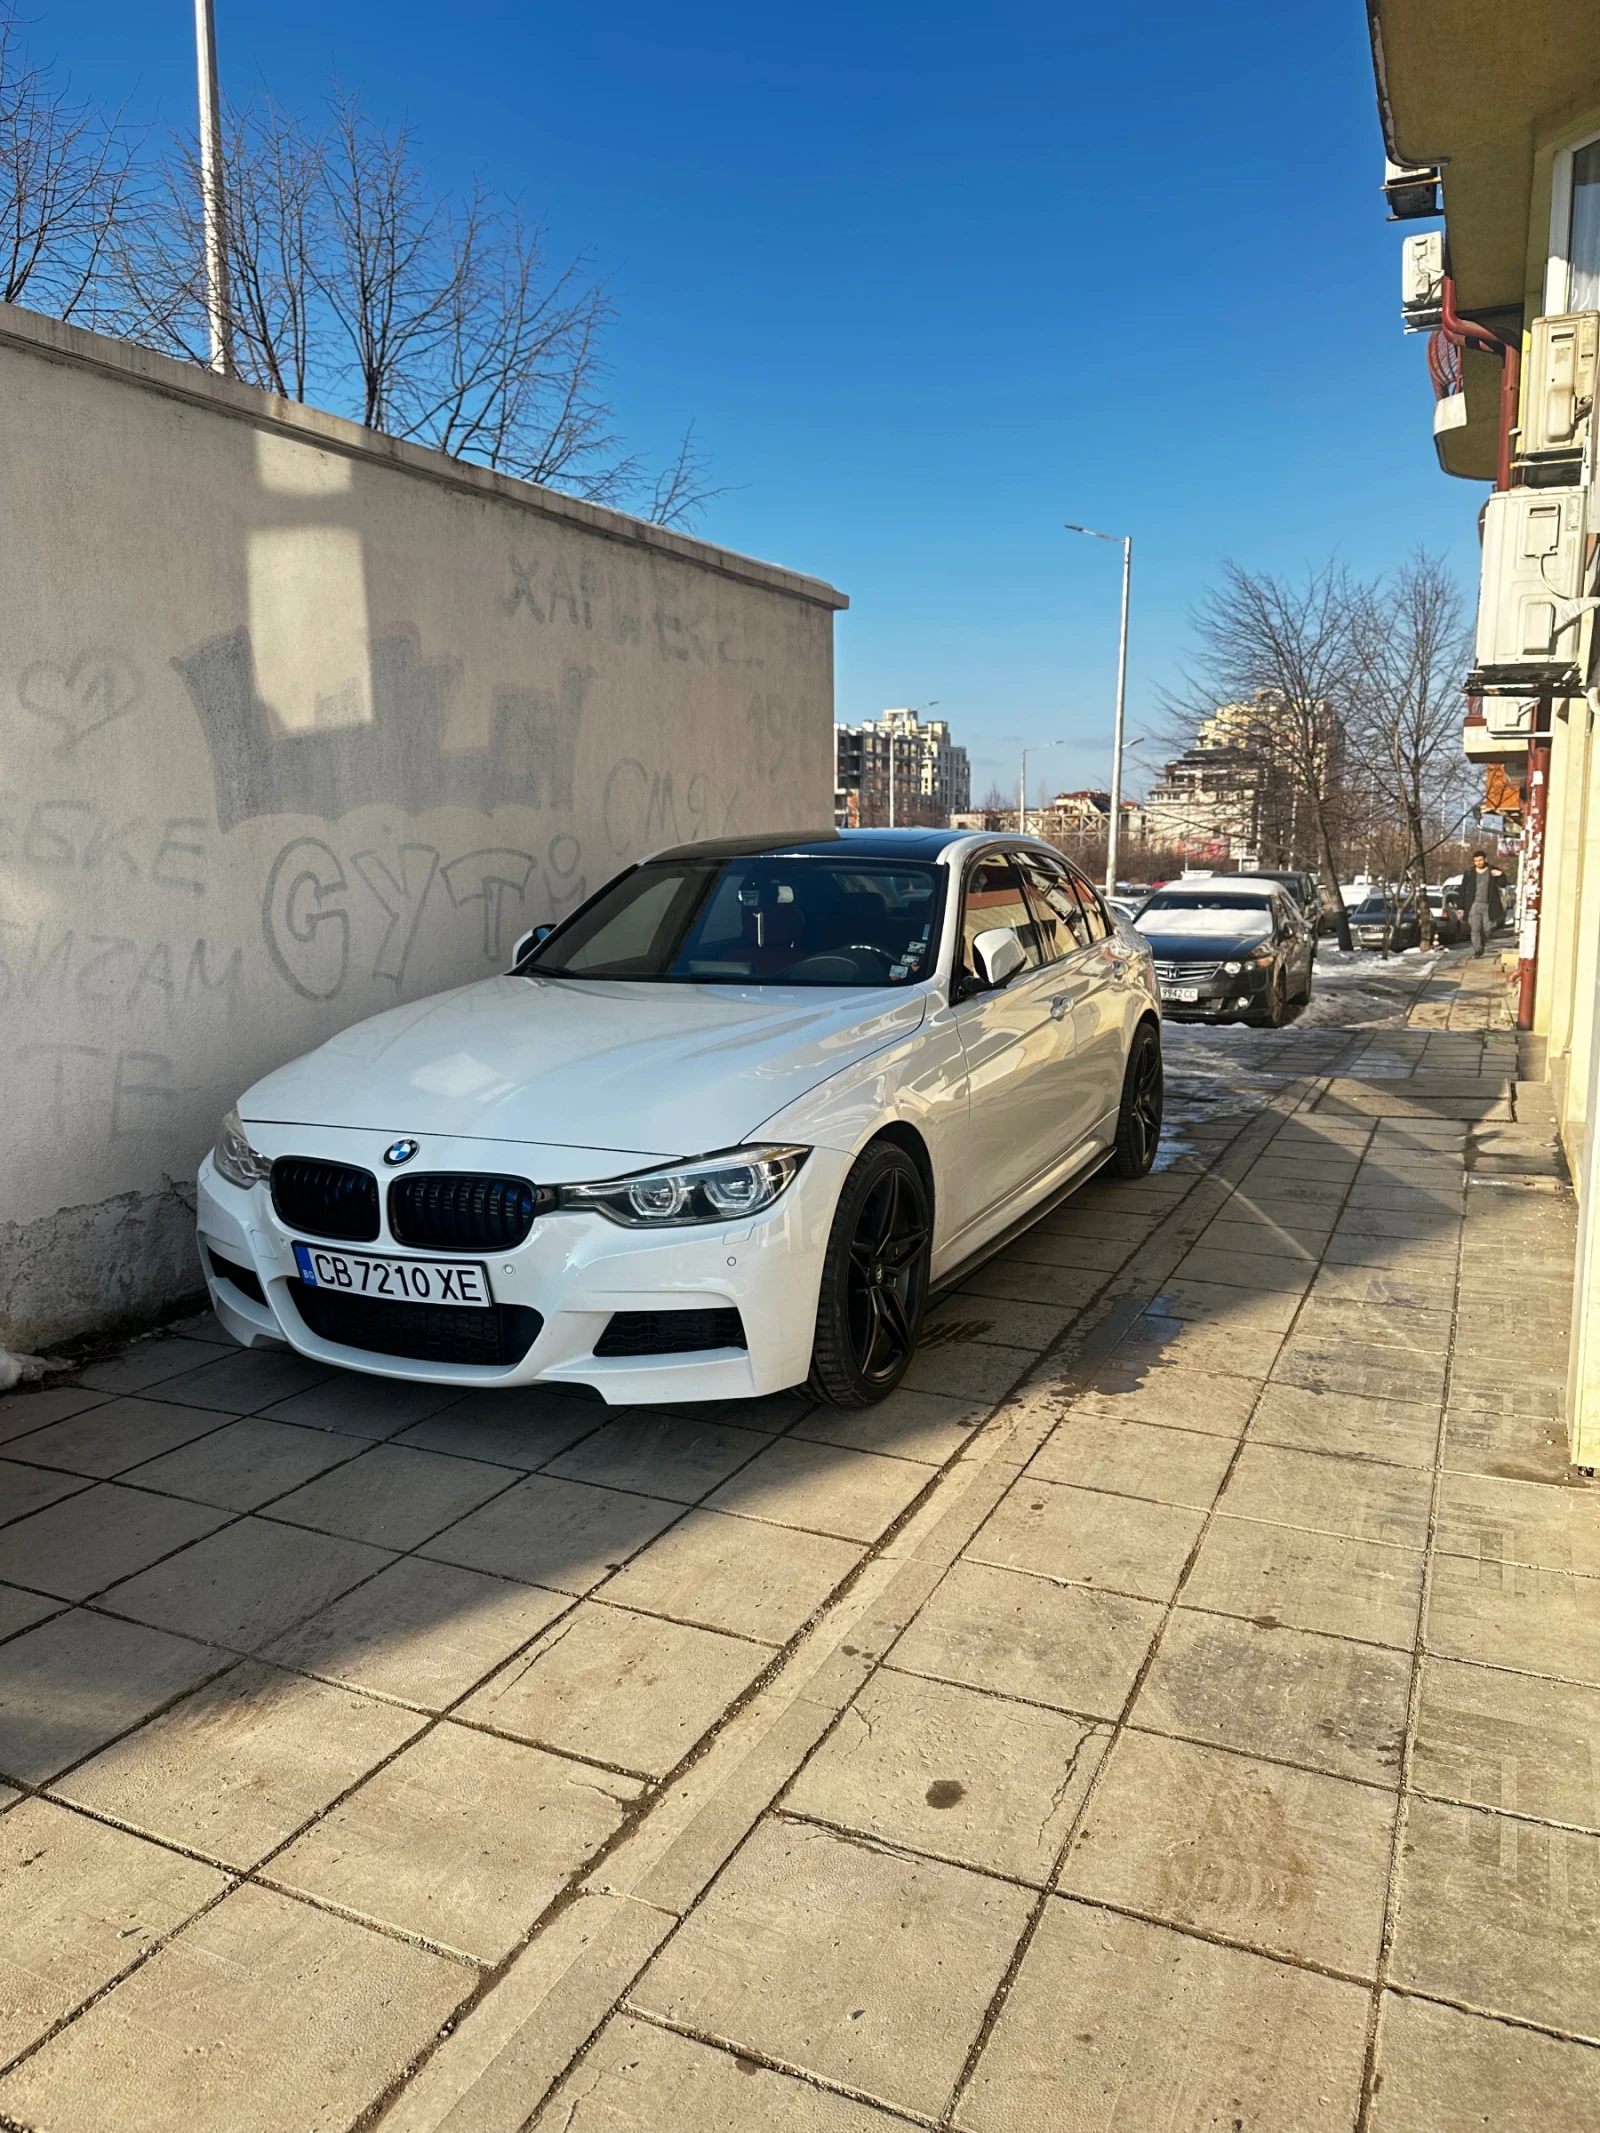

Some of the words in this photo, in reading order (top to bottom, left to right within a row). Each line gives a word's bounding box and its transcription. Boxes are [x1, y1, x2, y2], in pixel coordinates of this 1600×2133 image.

[1162, 988, 1182, 998] 9942
[1183, 989, 1196, 998] CC
[303, 1269, 315, 1280] BG
[315, 1254, 353, 1288] CB
[354, 1261, 431, 1298] 7210
[435, 1268, 482, 1302] XE
